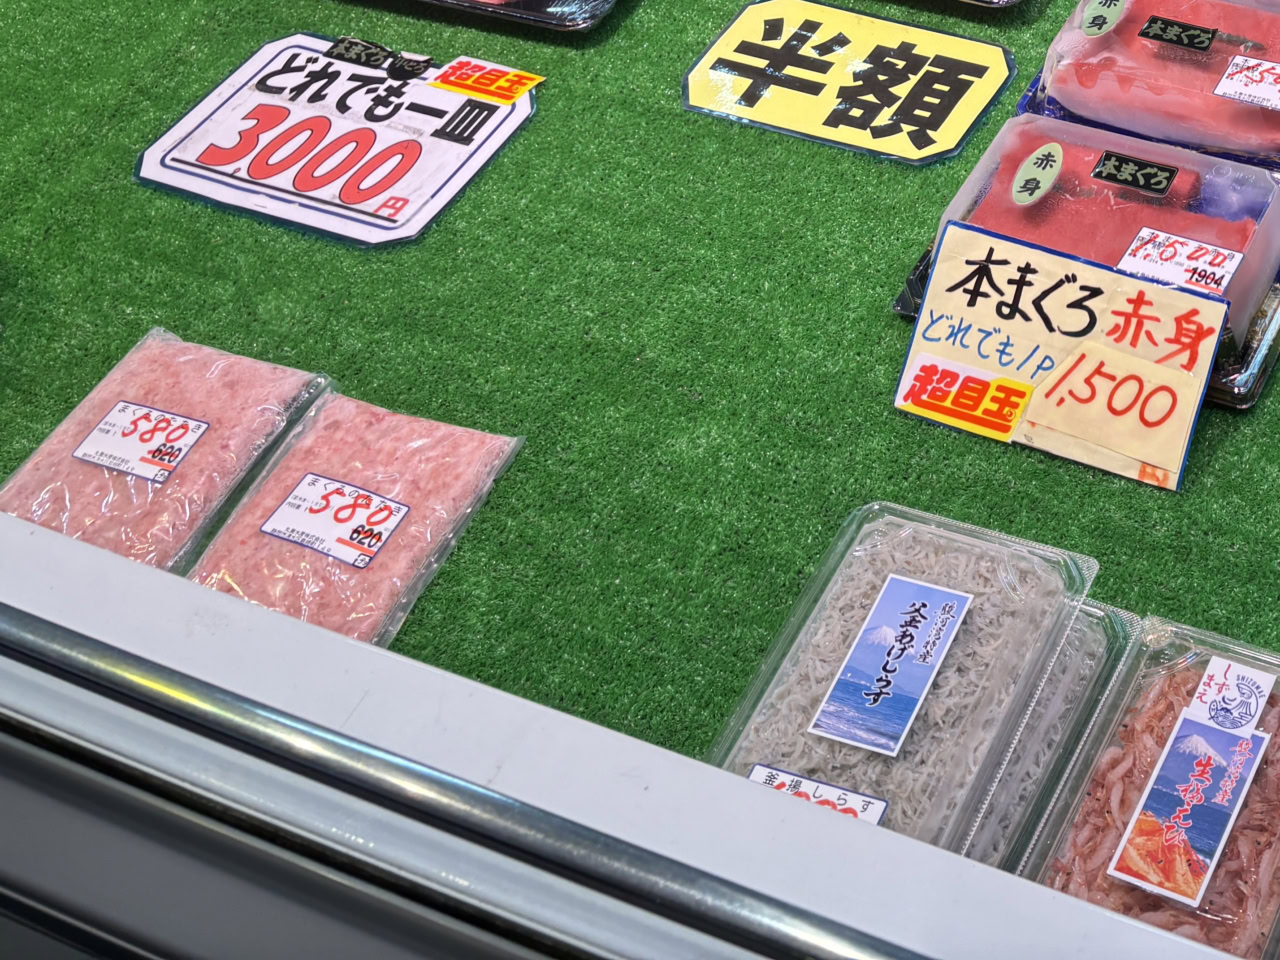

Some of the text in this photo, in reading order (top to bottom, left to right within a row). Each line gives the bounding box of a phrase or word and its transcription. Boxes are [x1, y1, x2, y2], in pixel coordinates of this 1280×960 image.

[330, 40, 391, 65] 本まぐろ
[1143, 21, 1215, 48] 本まぐろ
[256, 52, 503, 147] どれでも一皿
[435, 59, 538, 101] 超目玉
[709, 17, 990, 151] 半額
[1016, 151, 1057, 197] 赤身
[1100, 156, 1173, 191] 本まぐろ
[372, 195, 409, 219] 円
[1188, 267, 1224, 288] 1904
[945, 246, 1216, 373] 本まぐろ 赤身
[903, 362, 1027, 434] 超目玉
[1045, 352, 1178, 429] 1,500
[122, 412, 190, 444] 580
[152, 442, 183, 463] 620
[309, 488, 393, 527] 580
[349, 525, 382, 548] 620
[863, 601, 928, 707] 釜あげしらす
[1235, 673, 1266, 700] SHIZUMAE
[763, 771, 874, 813] 釜揚しらす
